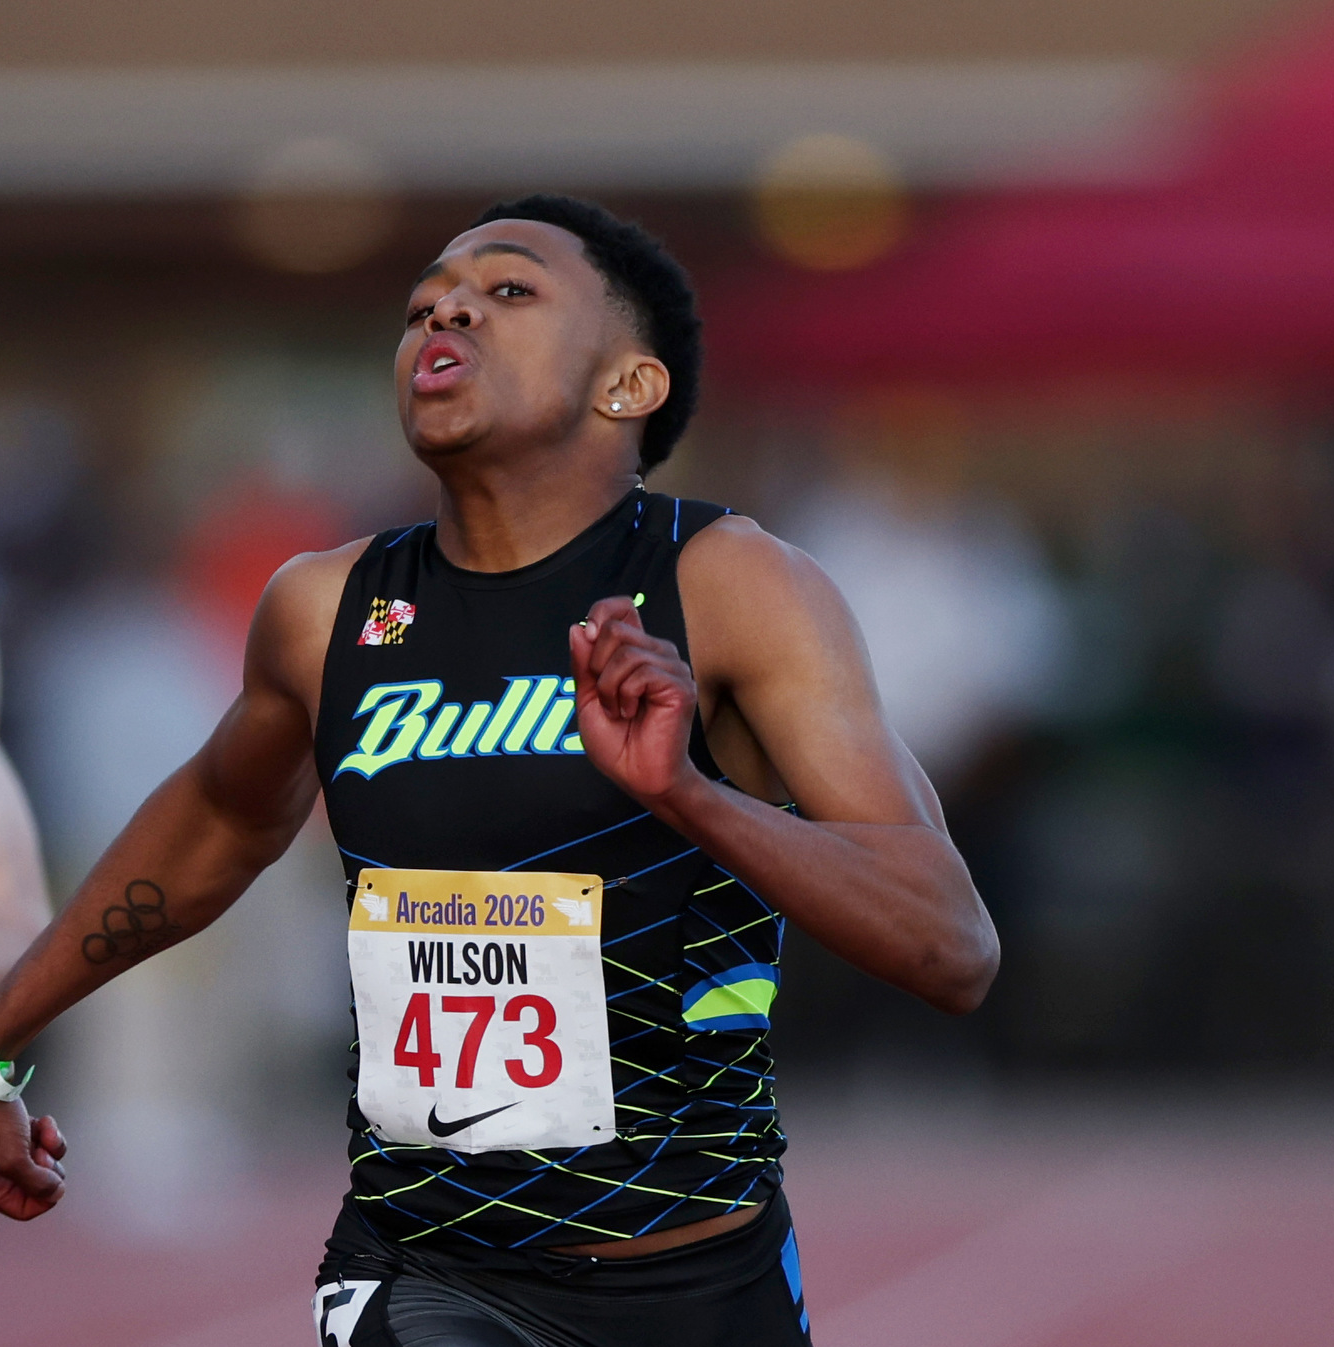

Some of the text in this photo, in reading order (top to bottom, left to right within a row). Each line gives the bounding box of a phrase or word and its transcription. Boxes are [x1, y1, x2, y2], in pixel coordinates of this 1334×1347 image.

[331, 675, 586, 783] Bulli
[396, 891, 545, 927] Arcadia 2026
[408, 940, 528, 985] WILSON
[393, 992, 563, 1089] 473
